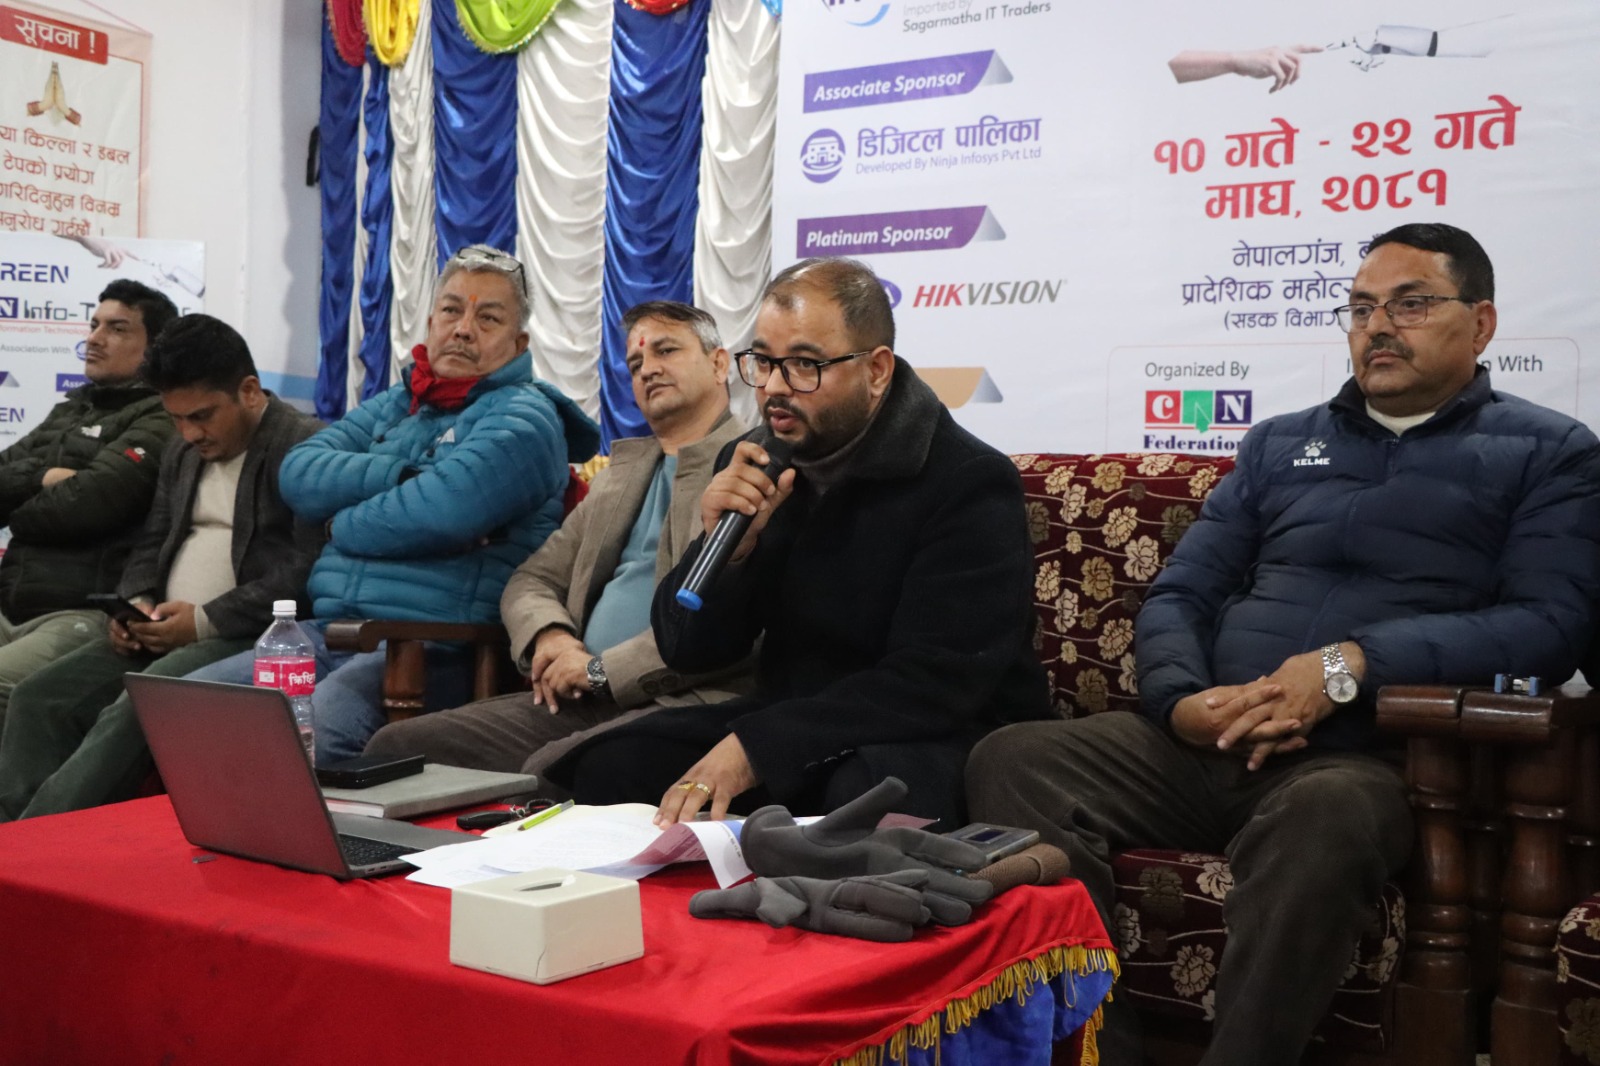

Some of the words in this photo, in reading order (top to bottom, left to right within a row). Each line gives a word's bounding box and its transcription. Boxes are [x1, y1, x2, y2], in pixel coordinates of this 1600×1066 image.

[13, 14, 80, 50] सूचना
[903, 11, 981, 33] Sagarmatha
[985, 6, 996, 20] IT
[1001, 2, 1051, 19] Traders
[813, 78, 890, 103] Associate
[894, 71, 966, 94] Sponsor
[23, 127, 77, 155] किल्ला
[98, 145, 131, 165] डबल
[857, 126, 945, 158] डिजिटल
[955, 115, 1042, 147] पालिका
[1153, 138, 1206, 174] १०
[1225, 117, 1299, 168] गते
[1351, 118, 1412, 158] २२
[1434, 94, 1522, 150] गते
[53, 162, 95, 185] प्रयोग
[856, 158, 911, 174] Developed
[914, 157, 927, 172] By
[930, 153, 958, 168] Ninja
[961, 149, 999, 165] Infosys
[1002, 149, 1019, 161] Pvt
[1023, 147, 1041, 160] Ltd
[1205, 179, 1301, 219] माघ,
[1321, 168, 1447, 212] २०८१
[806, 229, 878, 248] Platinum
[881, 225, 952, 246] Sponsor
[1232, 238, 1345, 267] नेपालगंज,
[0, 262, 69, 283] REEN
[913, 279, 1063, 308] HIKVISION
[1181, 275, 1274, 306] प्रादेशिक
[24, 299, 96, 321] Info-T
[1224, 310, 1278, 330] (सडक
[1145, 361, 1225, 381] Organized
[1230, 361, 1249, 380] By
[1498, 355, 1543, 372] With
[1293, 457, 1330, 467] KELME
